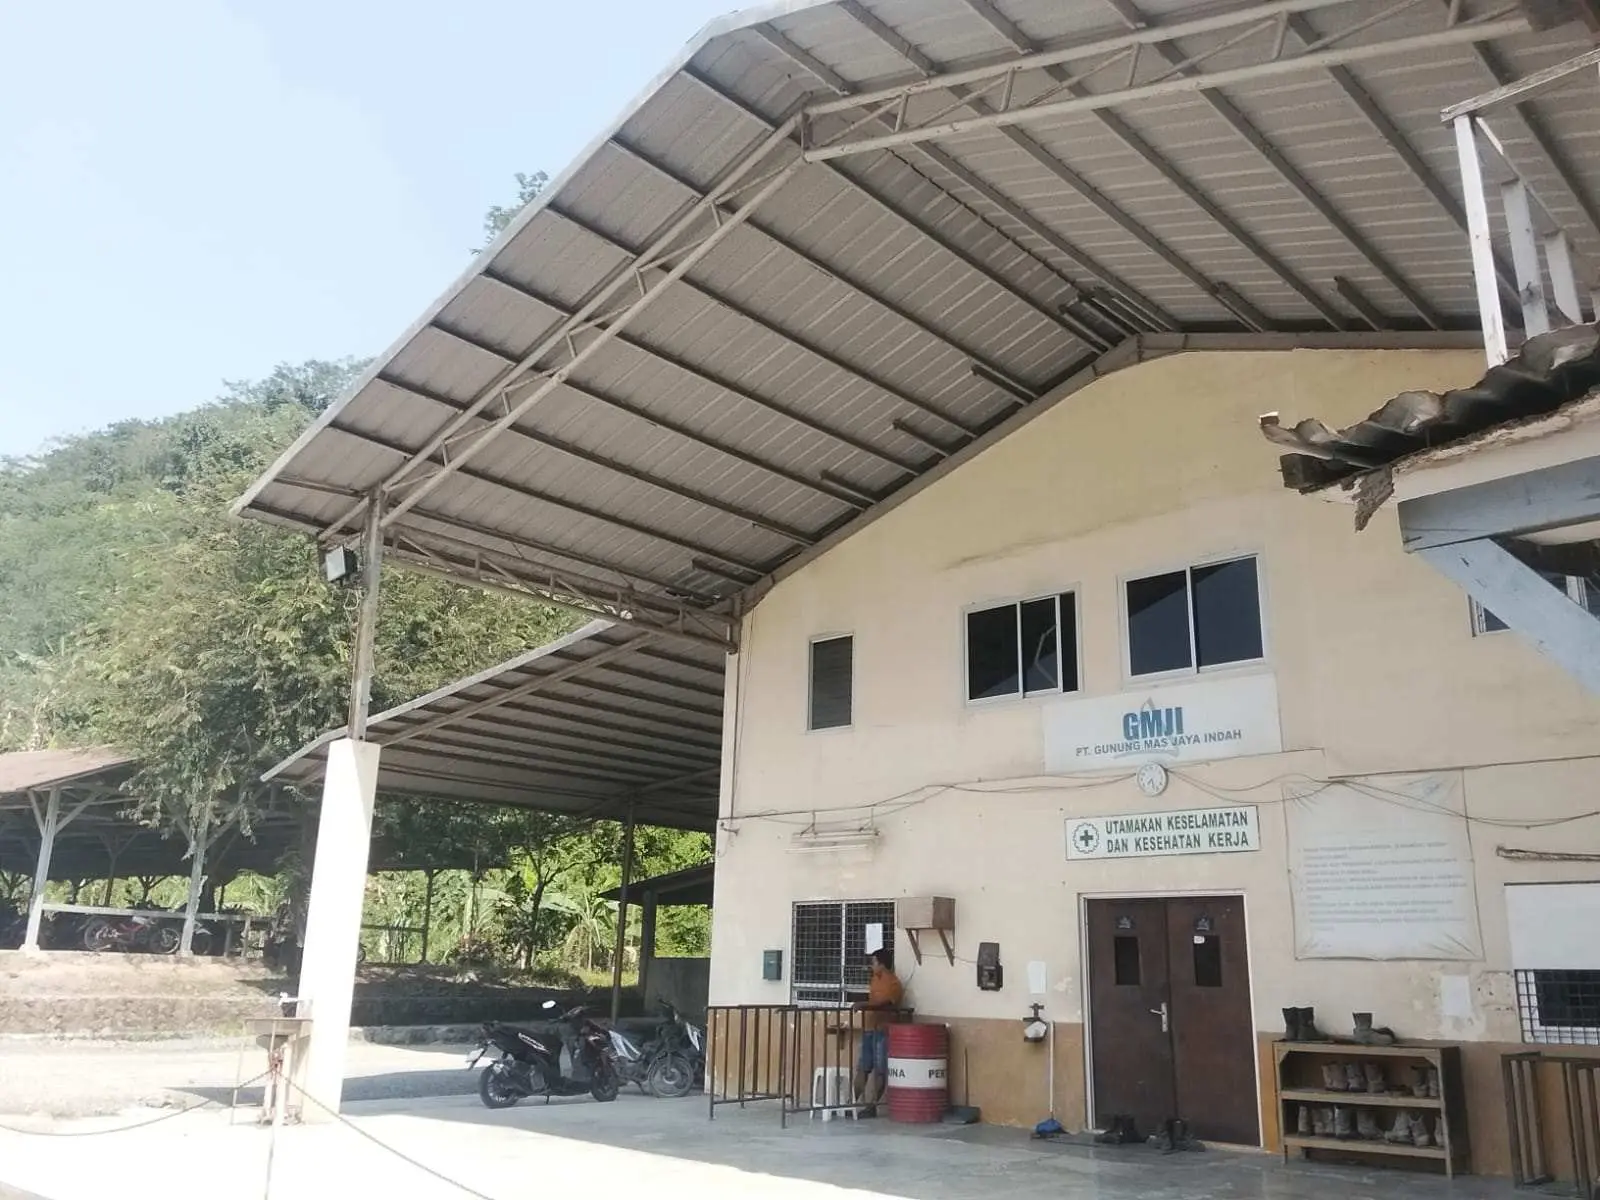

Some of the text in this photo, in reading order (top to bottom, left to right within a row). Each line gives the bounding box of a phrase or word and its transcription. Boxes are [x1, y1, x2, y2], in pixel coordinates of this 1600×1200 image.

[1123, 707, 1184, 741] GMJI
[1094, 741, 1141, 755] GUNUNG
[1144, 738, 1169, 750] MAS
[1172, 734, 1201, 746] JAYA
[1204, 729, 1242, 743] INDAH
[1105, 811, 1249, 835] UTAMAKAN KESELAMATAN
[1107, 831, 1249, 853] DAN KESEHATAN KERJA
